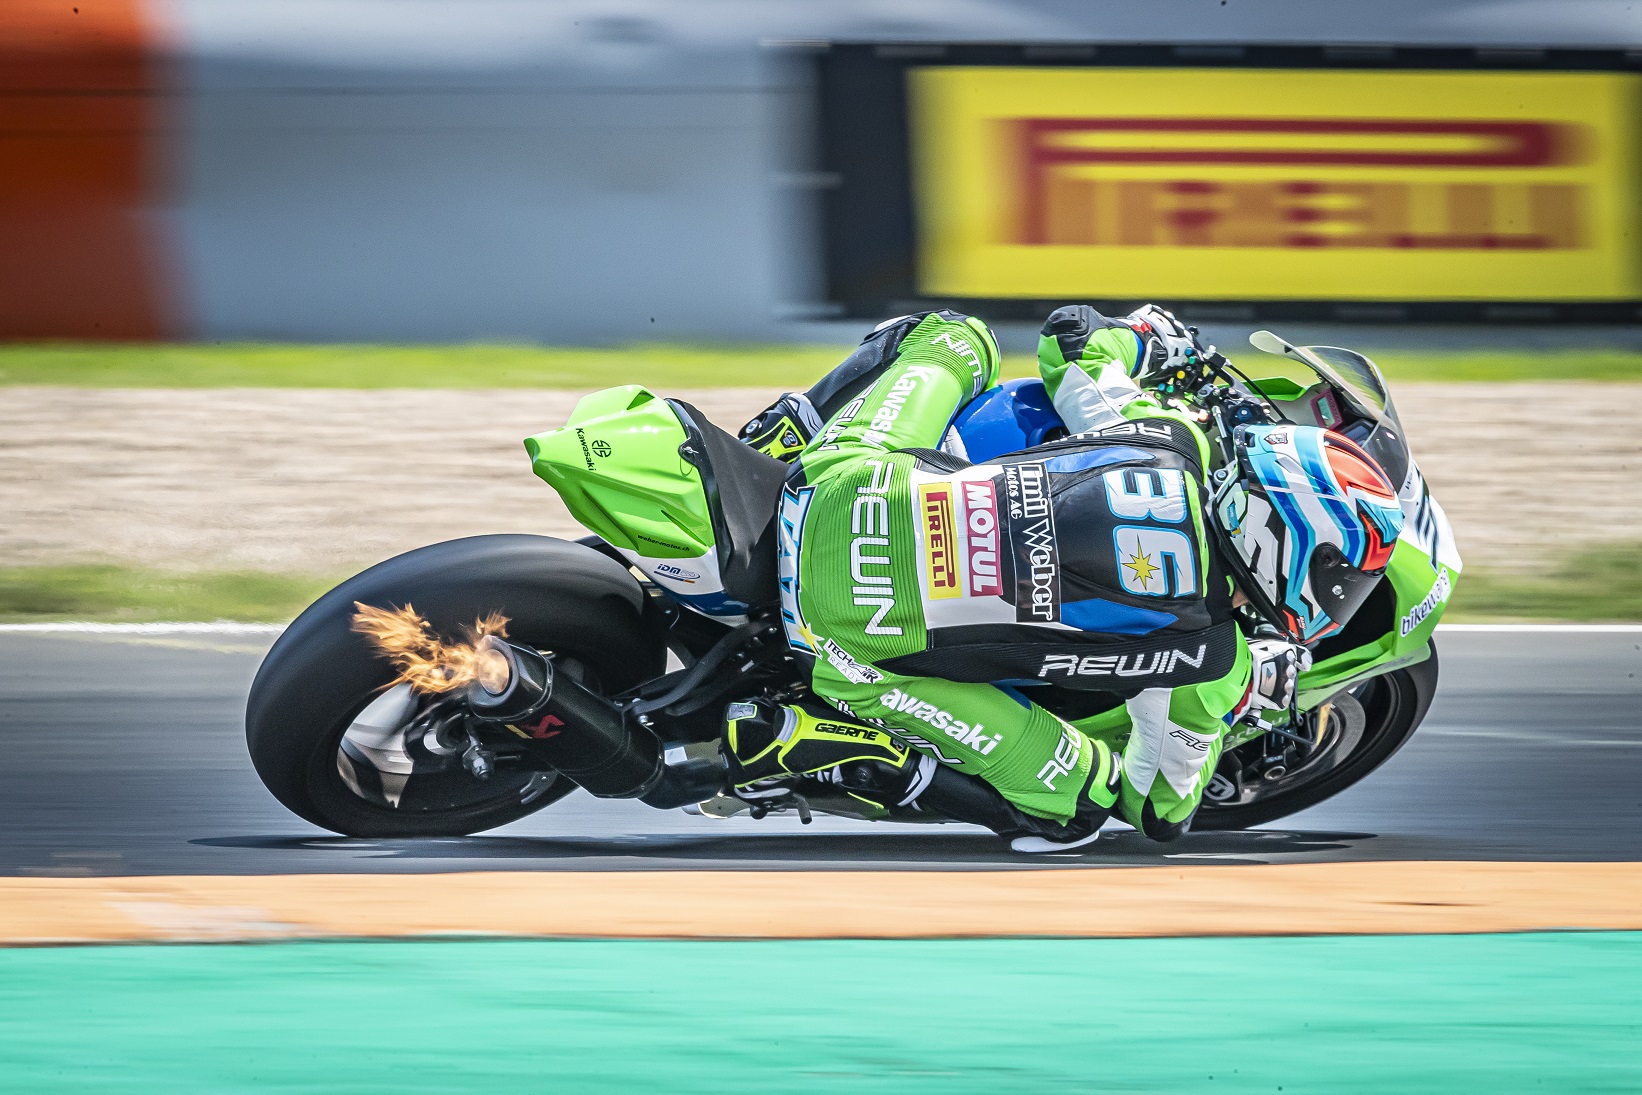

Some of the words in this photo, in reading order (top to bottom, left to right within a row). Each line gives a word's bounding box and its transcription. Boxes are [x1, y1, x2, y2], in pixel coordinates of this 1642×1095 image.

[575, 428, 597, 471] Kawasaki
[1005, 466, 1020, 498] Motos
[850, 460, 904, 636] REWIN
[925, 492, 957, 588] PIRELLI
[965, 484, 998, 593] MOTUL
[1009, 498, 1023, 520] AG
[1102, 467, 1197, 598] 36
[1022, 518, 1053, 621] Weber
[1038, 644, 1207, 677] REWIN
[880, 687, 1003, 756] awasaki
